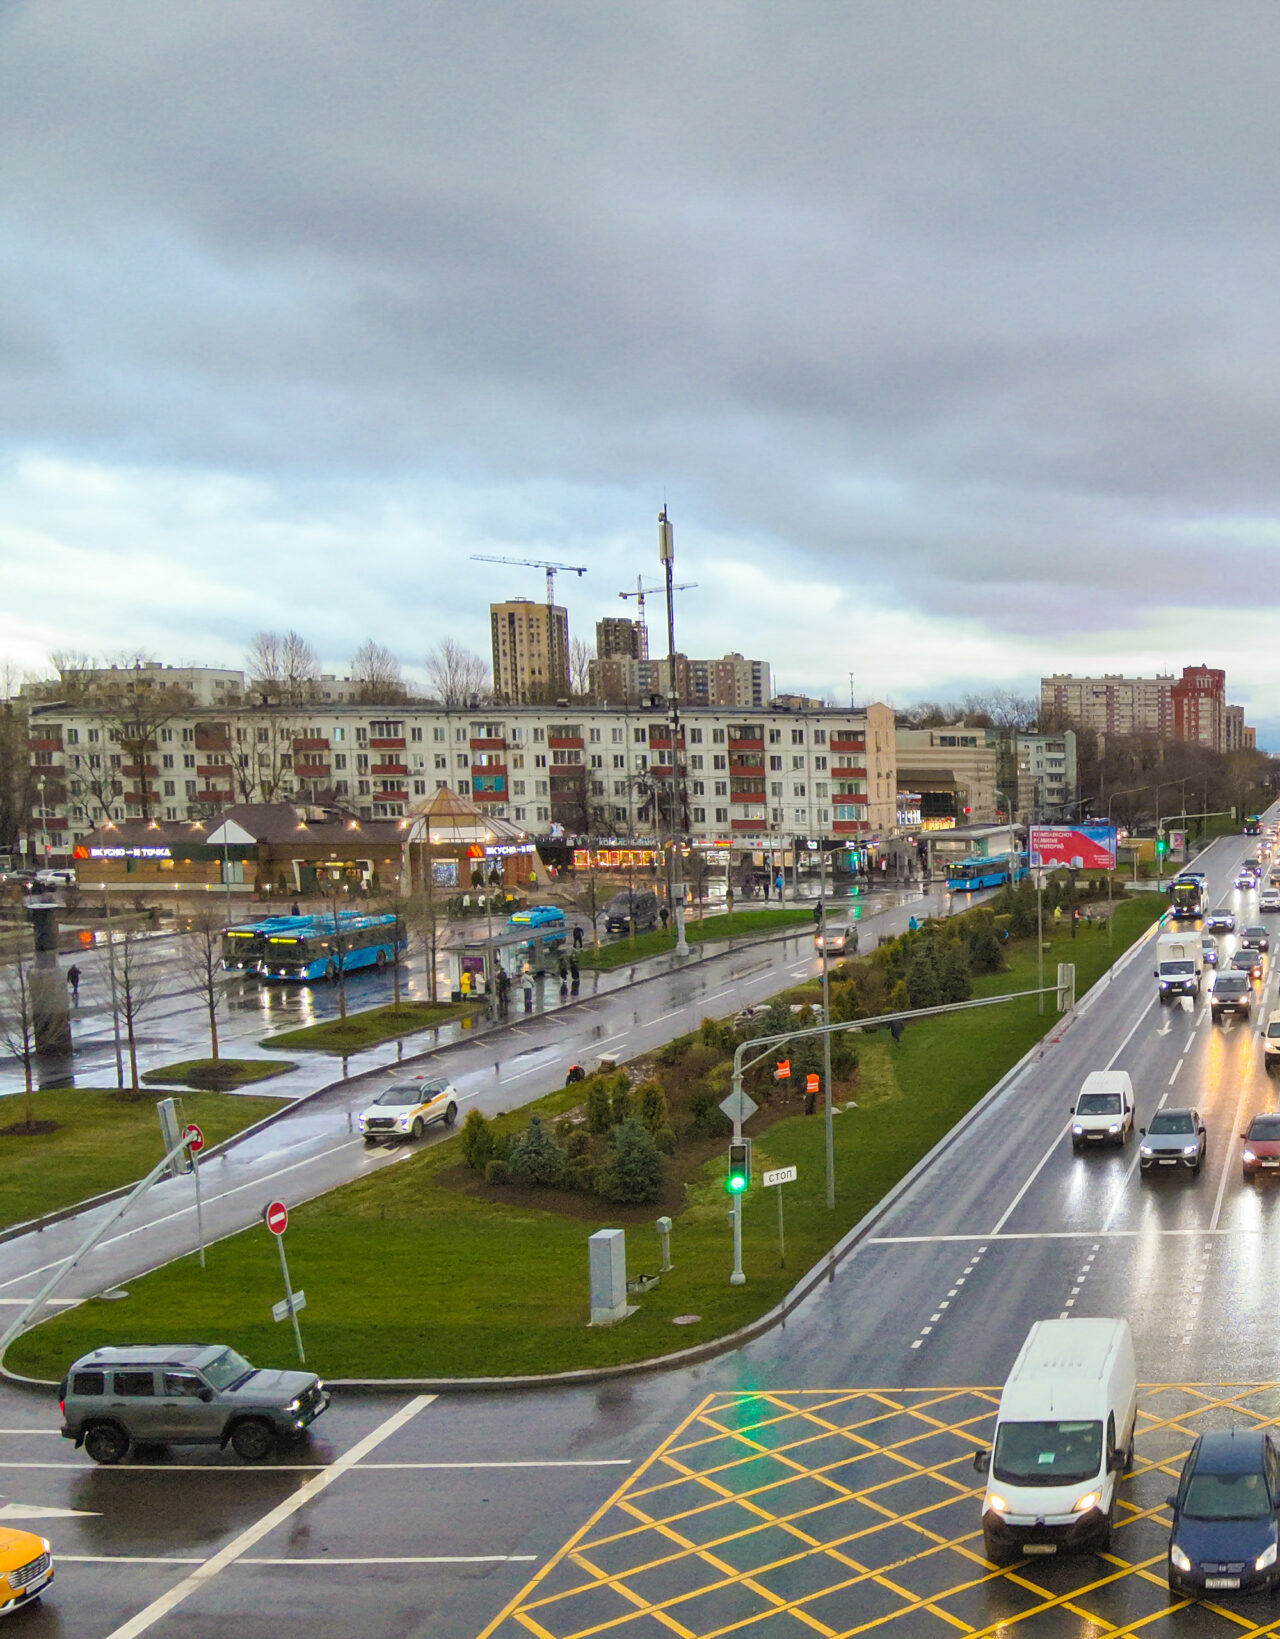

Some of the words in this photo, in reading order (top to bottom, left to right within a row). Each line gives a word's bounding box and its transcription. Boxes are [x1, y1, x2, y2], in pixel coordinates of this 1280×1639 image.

[91, 848, 126, 857] ВКУСНО
[142, 848, 172, 857] ТОЧКА
[486, 846, 516, 855] ВКУСНО
[768, 1170, 792, 1183] СТОП
